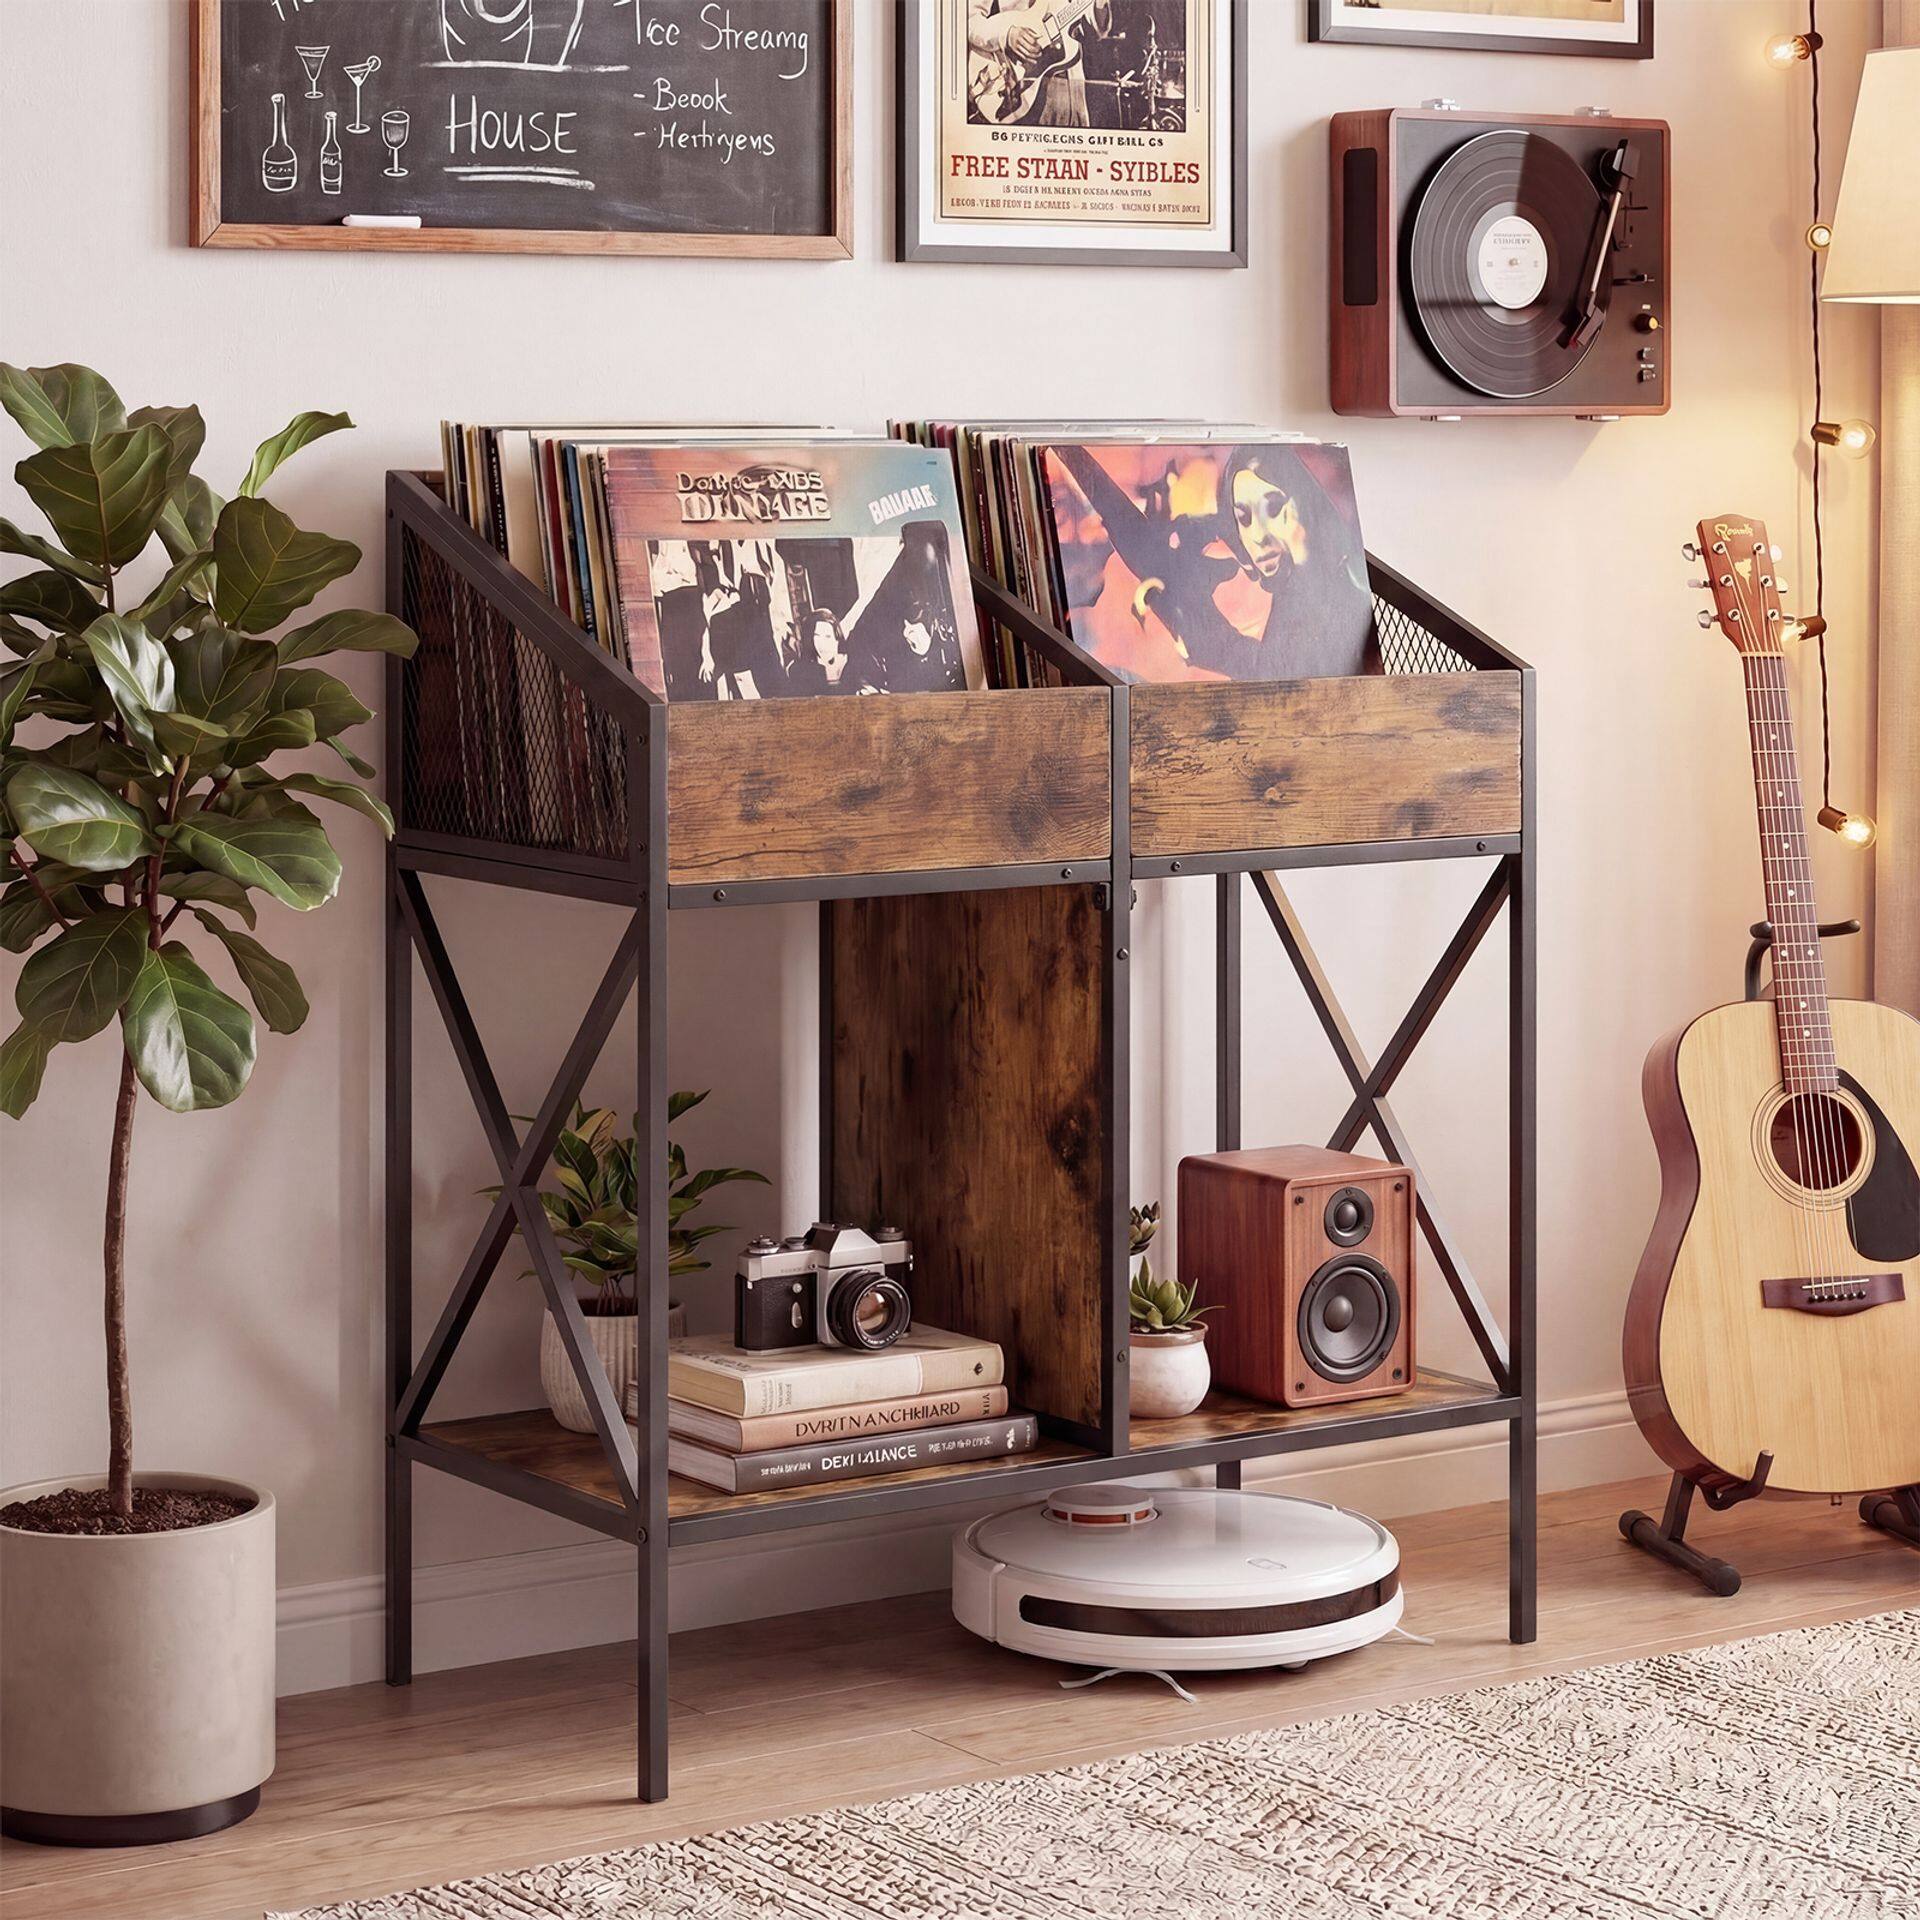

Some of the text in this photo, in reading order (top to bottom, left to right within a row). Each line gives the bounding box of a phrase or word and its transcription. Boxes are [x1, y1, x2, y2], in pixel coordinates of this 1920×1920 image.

[445, 93, 578, 154] HOUSE
[951, 155, 1009, 178] FREE
[1017, 157, 1089, 180] STAAN
[1110, 160, 1200, 184] SYIBLES
